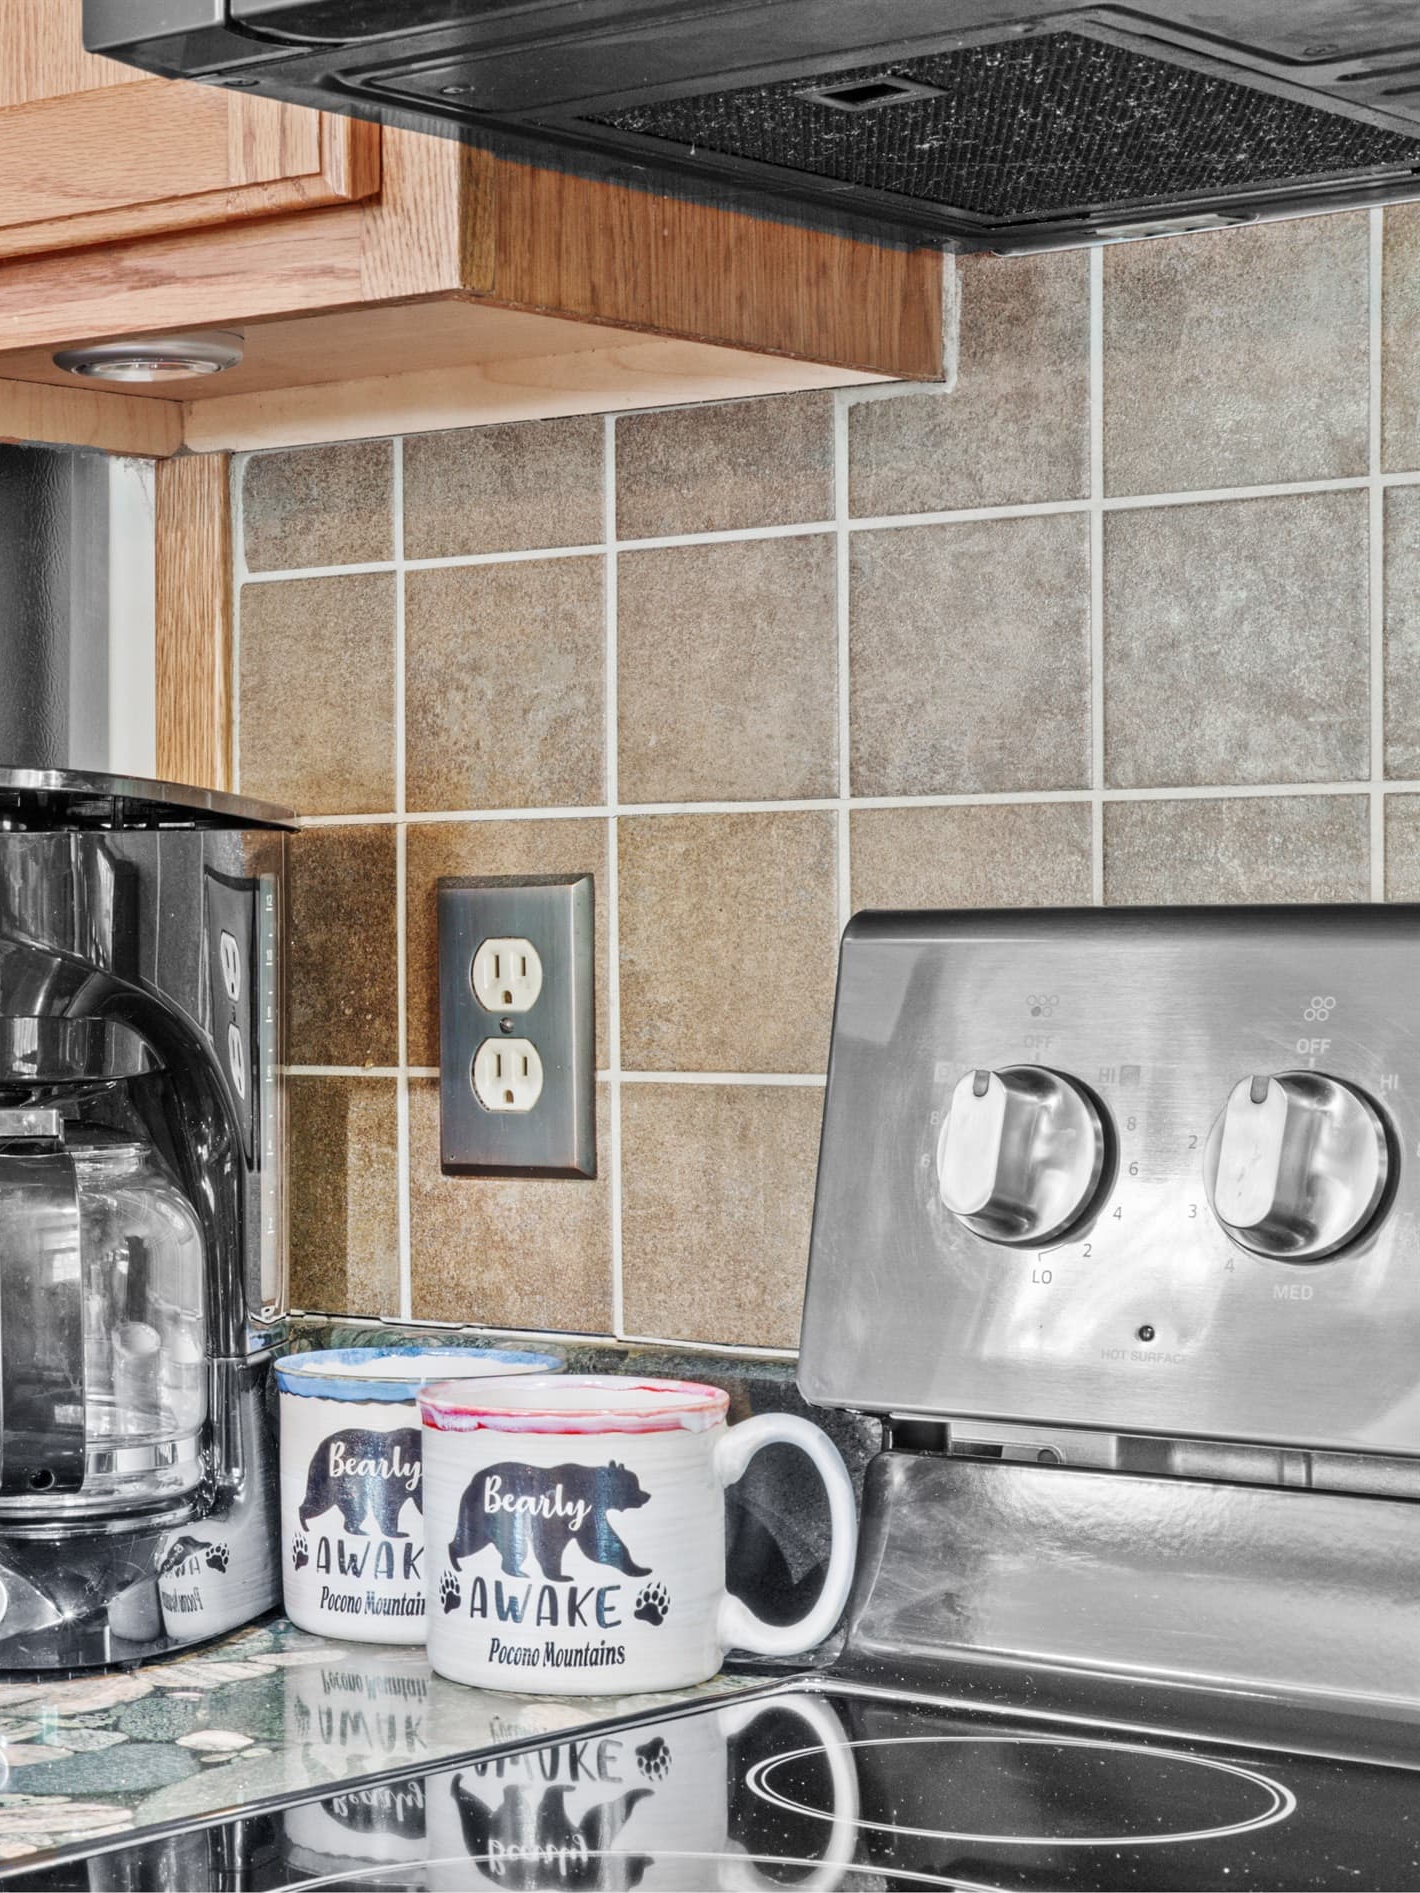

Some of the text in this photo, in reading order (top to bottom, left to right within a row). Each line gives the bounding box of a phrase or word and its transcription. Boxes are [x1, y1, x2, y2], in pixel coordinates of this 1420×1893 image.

[1023, 1035, 1053, 1048] OFF
[1296, 1038, 1331, 1054] OFF
[1098, 1067, 1116, 1083] HI
[1380, 1073, 1399, 1090] HI
[1126, 1116, 1136, 1131] 8
[1188, 1135, 1198, 1150] 2
[1129, 1161, 1139, 1176] 6
[1112, 1206, 1123, 1220] 4
[1188, 1204, 1197, 1218] 3
[1083, 1243, 1092, 1258] 2
[1224, 1258, 1235, 1272] 4
[1032, 1270, 1052, 1285] LO
[1273, 1285, 1314, 1300] MED
[1101, 1348, 1185, 1365] HOT SURFAC
[330, 1441, 422, 1491] Bearly
[484, 1475, 592, 1531] Bearly
[317, 1536, 424, 1580] AWAK
[320, 1586, 425, 1616] Pocono Mountai
[470, 1576, 622, 1629] AWAKE
[488, 1638, 625, 1668] Pocono Mountains
